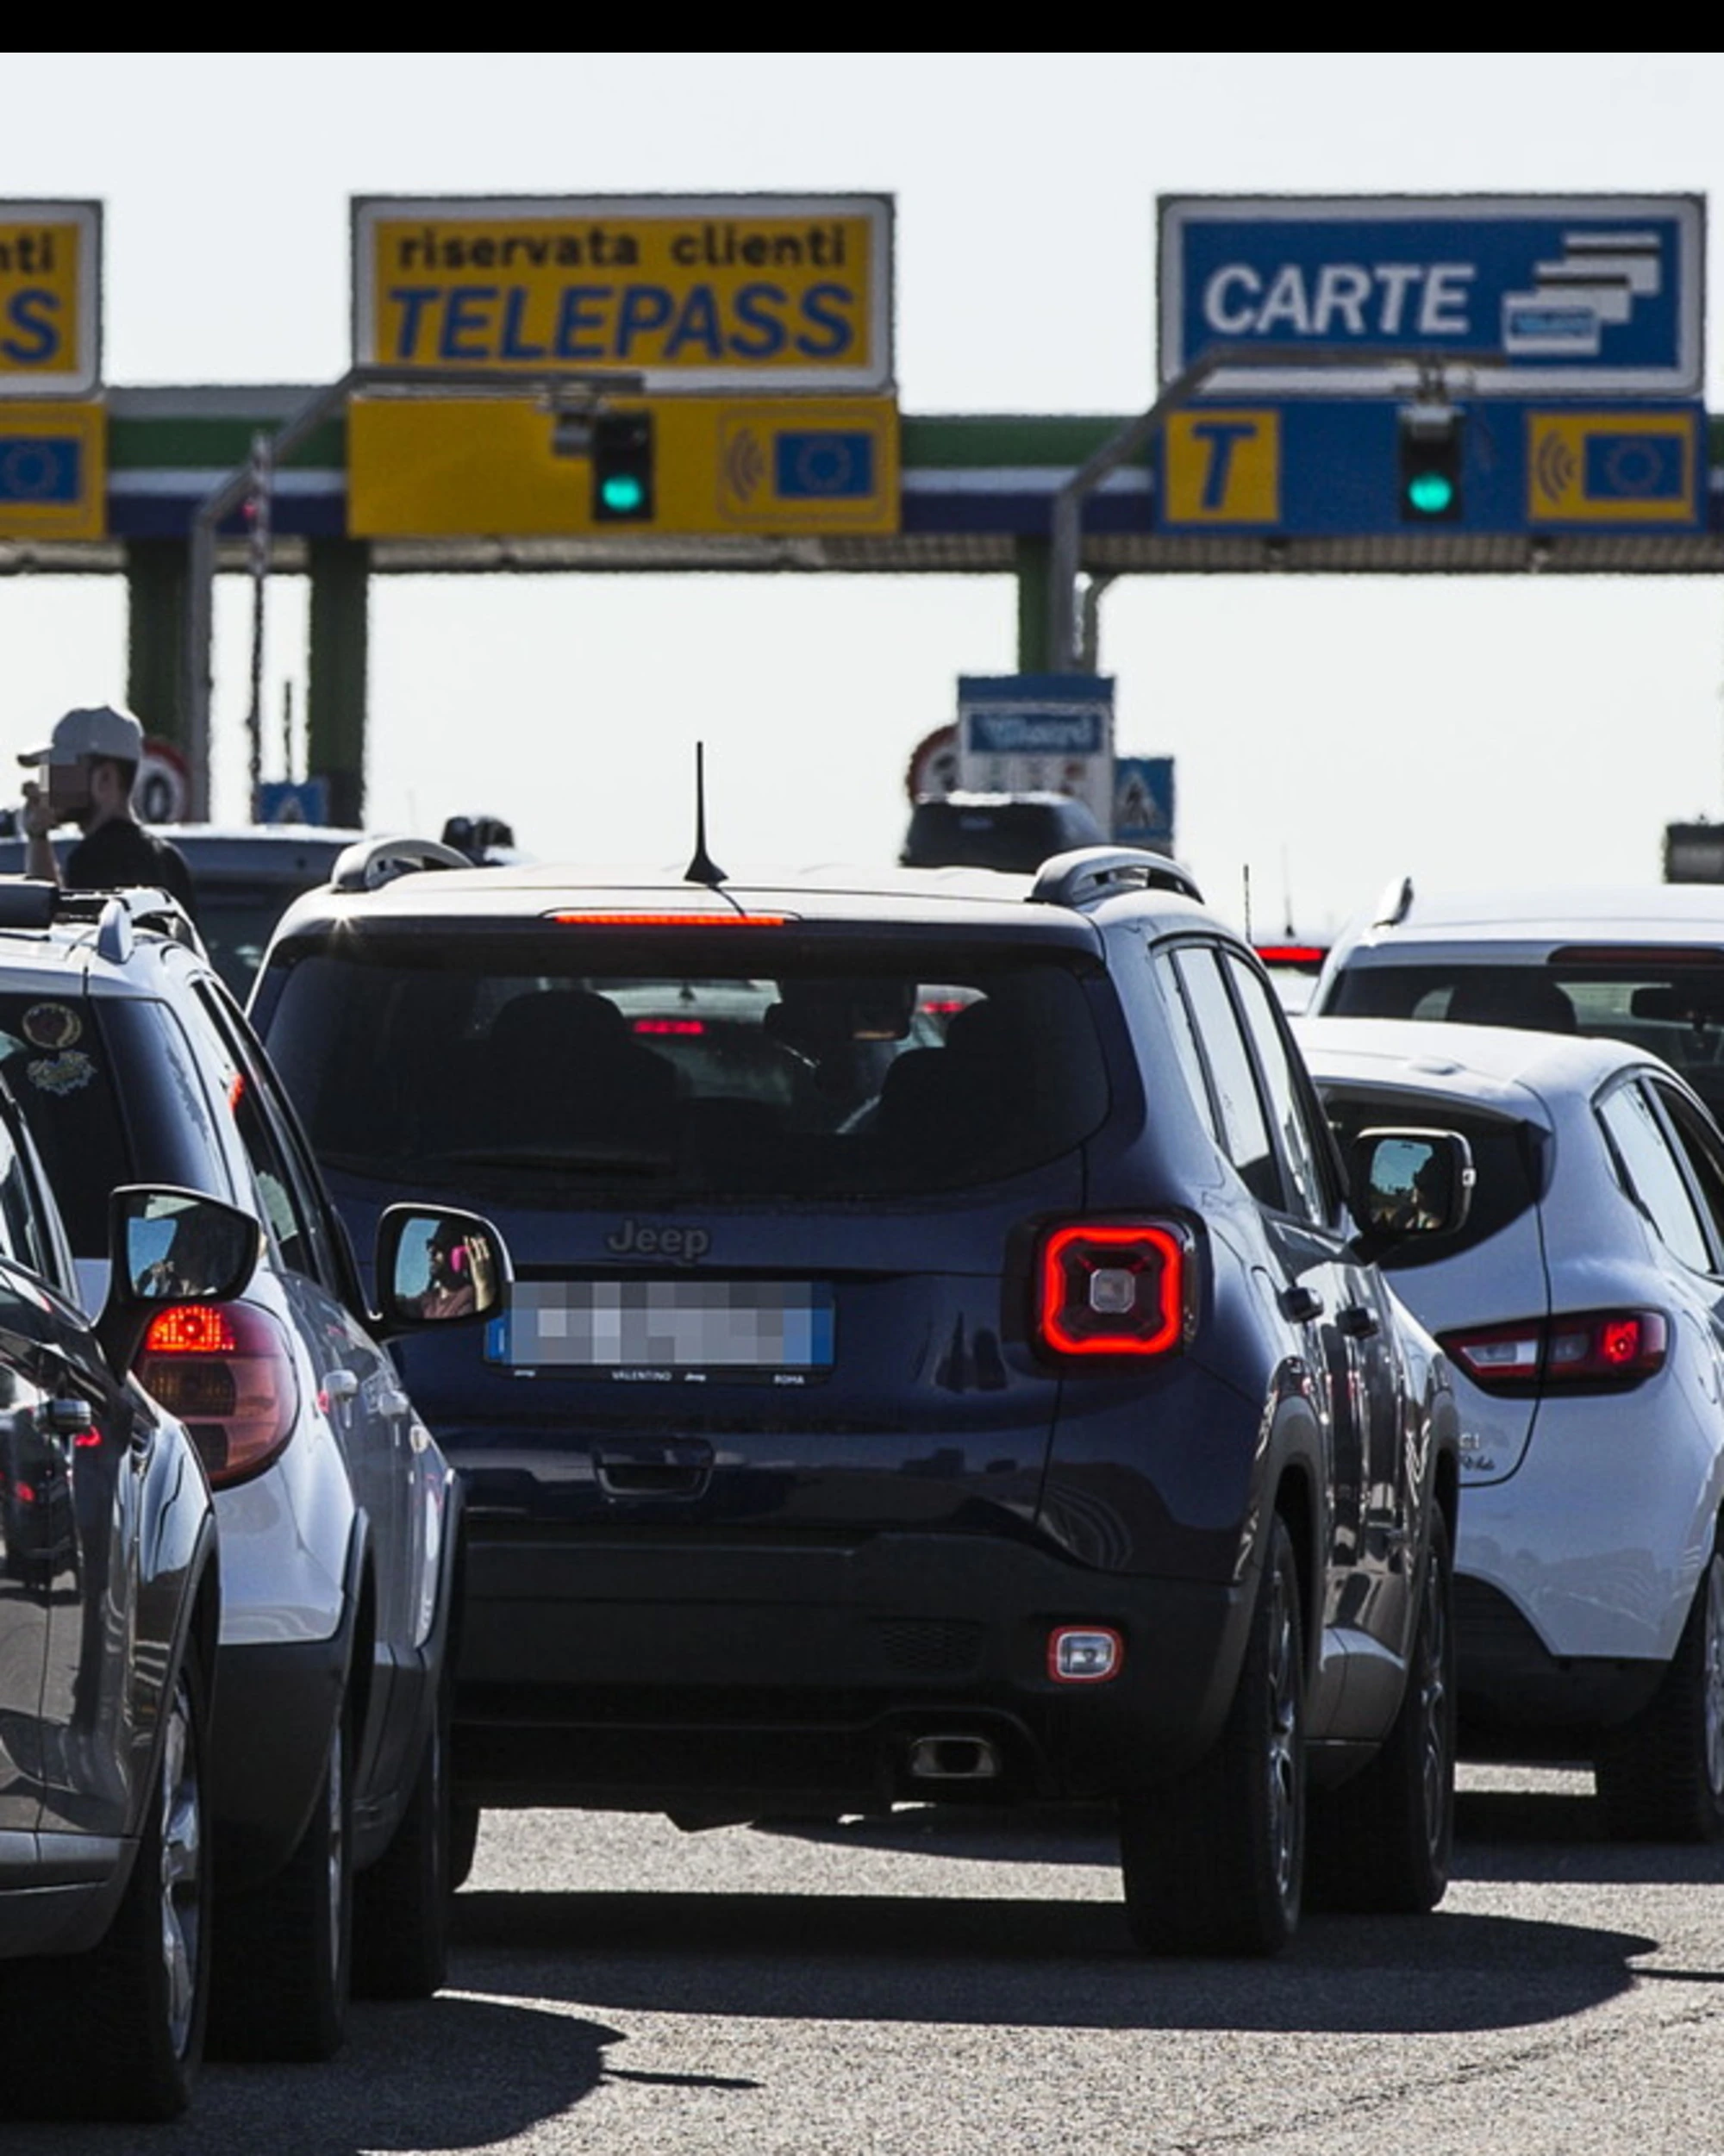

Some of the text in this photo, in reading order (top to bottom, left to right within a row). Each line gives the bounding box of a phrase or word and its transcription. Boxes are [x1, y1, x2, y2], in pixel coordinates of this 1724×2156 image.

[399, 226, 846, 269] riservata clienti
[390, 284, 853, 359] TELEPASS
[1204, 264, 1475, 334] CARTE
[1191, 422, 1258, 511] T
[608, 1220, 709, 1259] Jeep
